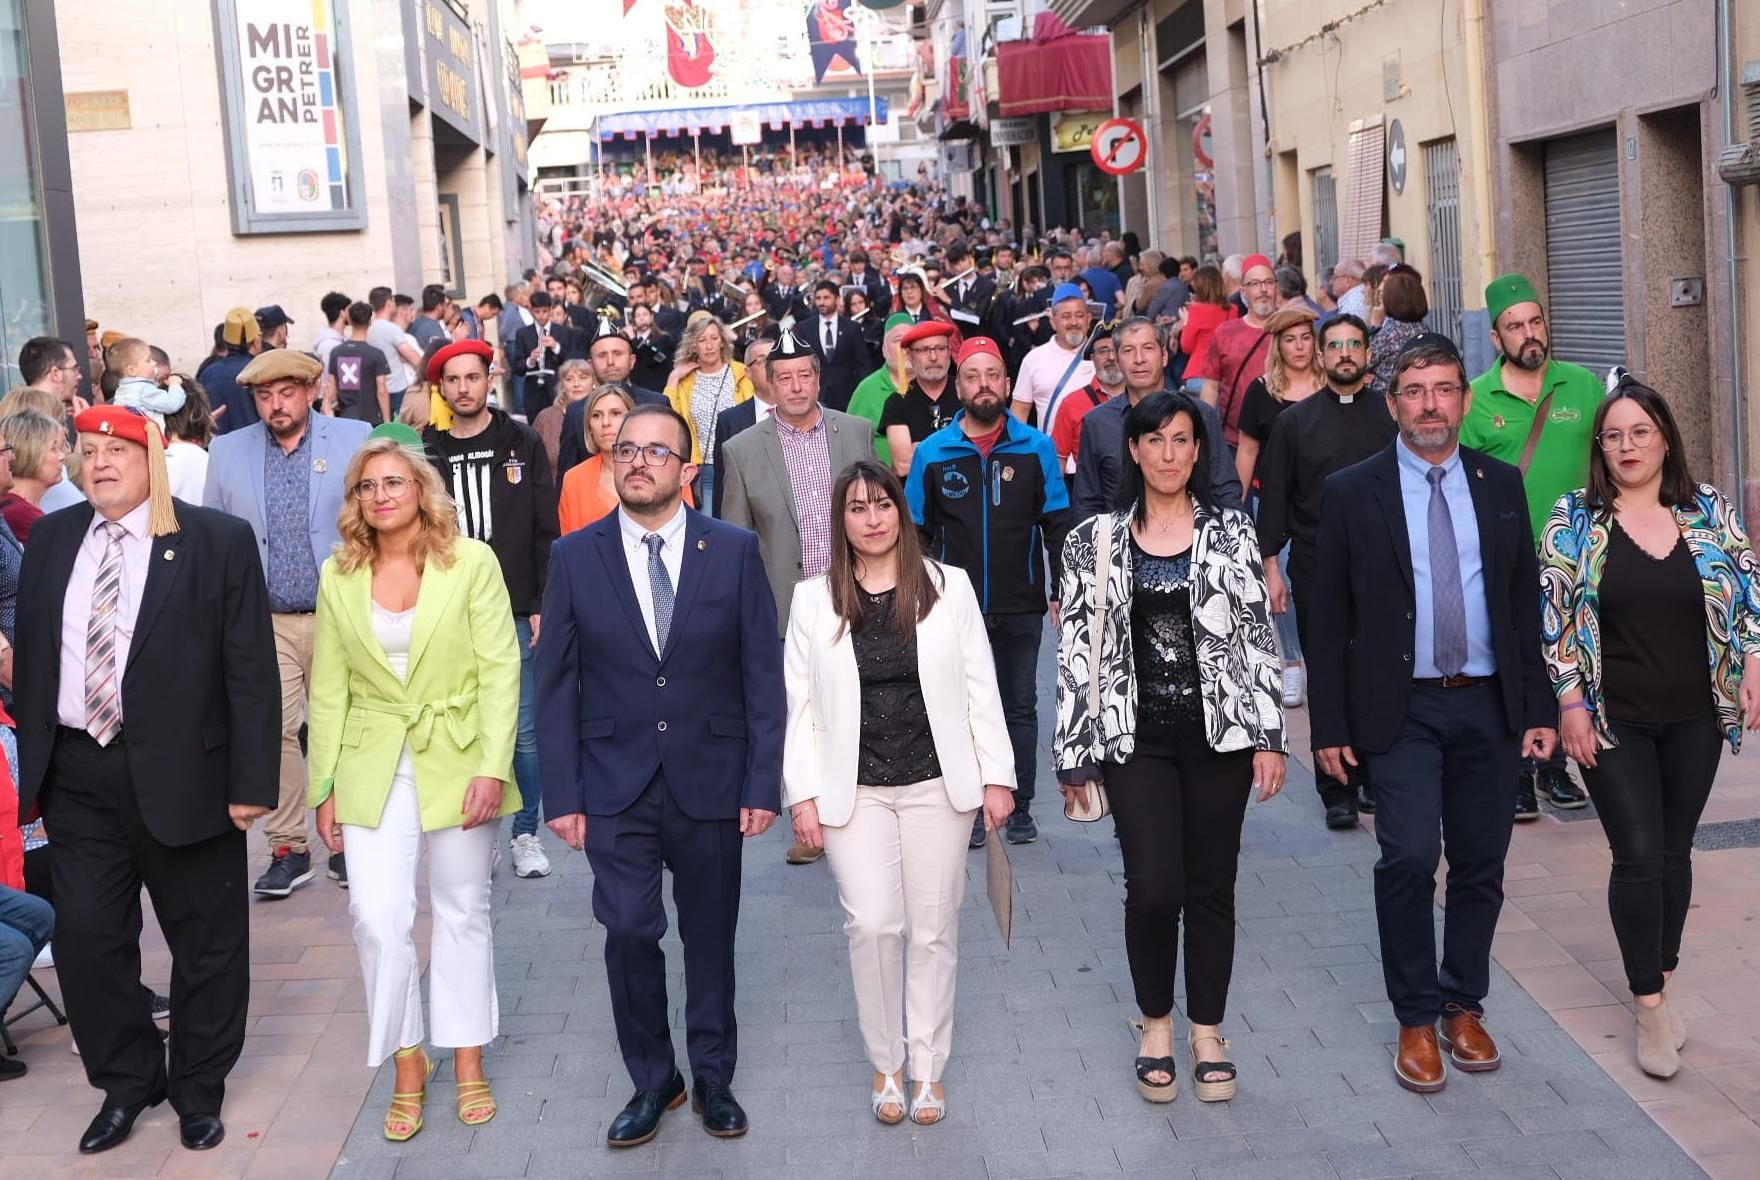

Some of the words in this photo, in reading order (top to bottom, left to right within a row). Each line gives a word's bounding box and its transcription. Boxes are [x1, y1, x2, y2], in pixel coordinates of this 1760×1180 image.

[246, 23, 292, 59] MI
[252, 65, 295, 93] GR
[296, 25, 318, 123] PETRER
[256, 97, 299, 124] AN
